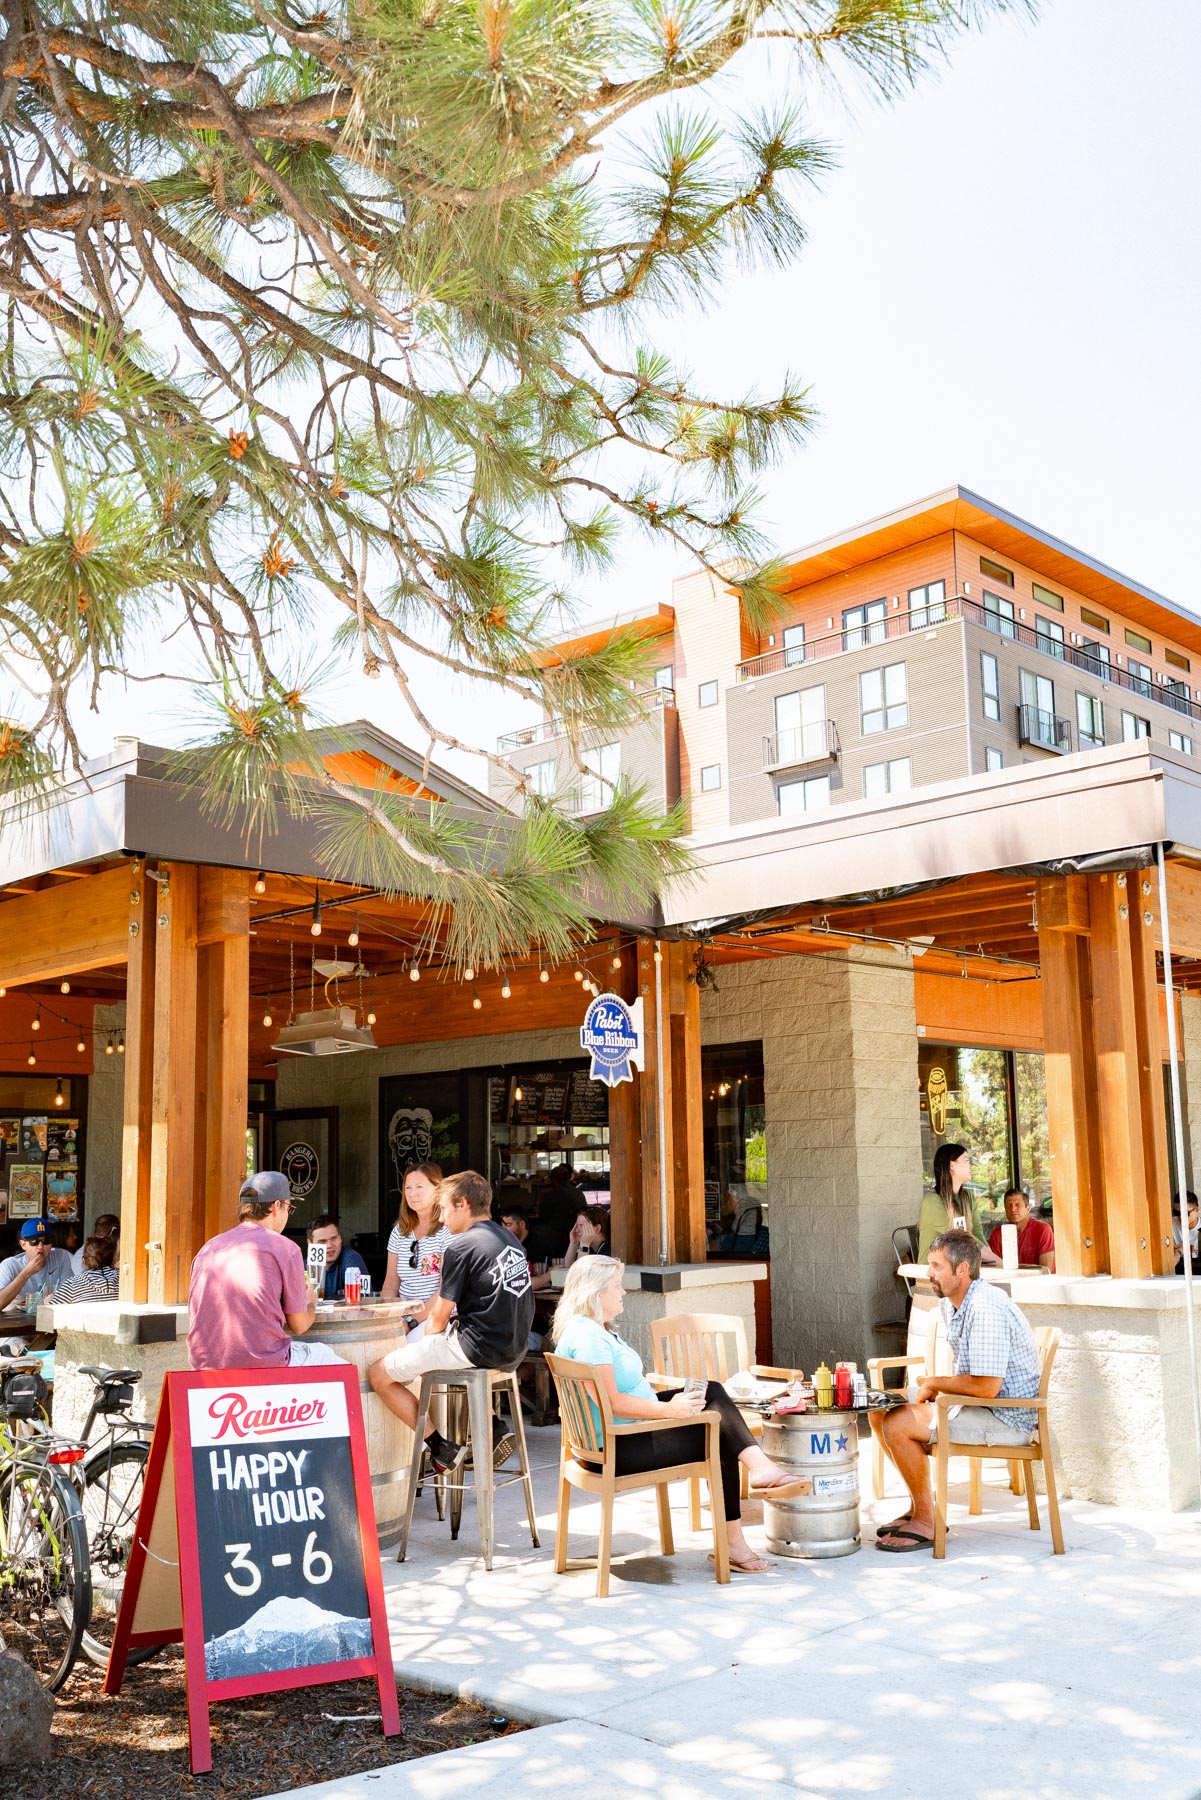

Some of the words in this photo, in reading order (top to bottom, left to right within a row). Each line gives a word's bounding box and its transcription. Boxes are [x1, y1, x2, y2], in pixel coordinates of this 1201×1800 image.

[594, 1006, 624, 1030] Pabst
[584, 1029, 604, 1046] Blue
[604, 1031, 637, 1048] Ribbon
[285, 1145, 315, 1161] BANGERS
[291, 1179, 314, 1193] BREWS
[310, 1247, 324, 1263] 38
[208, 1393, 329, 1440] Rainier
[811, 1433, 831, 1454] M
[209, 1449, 308, 1490] HAPPY
[252, 1486, 326, 1527] HOUR
